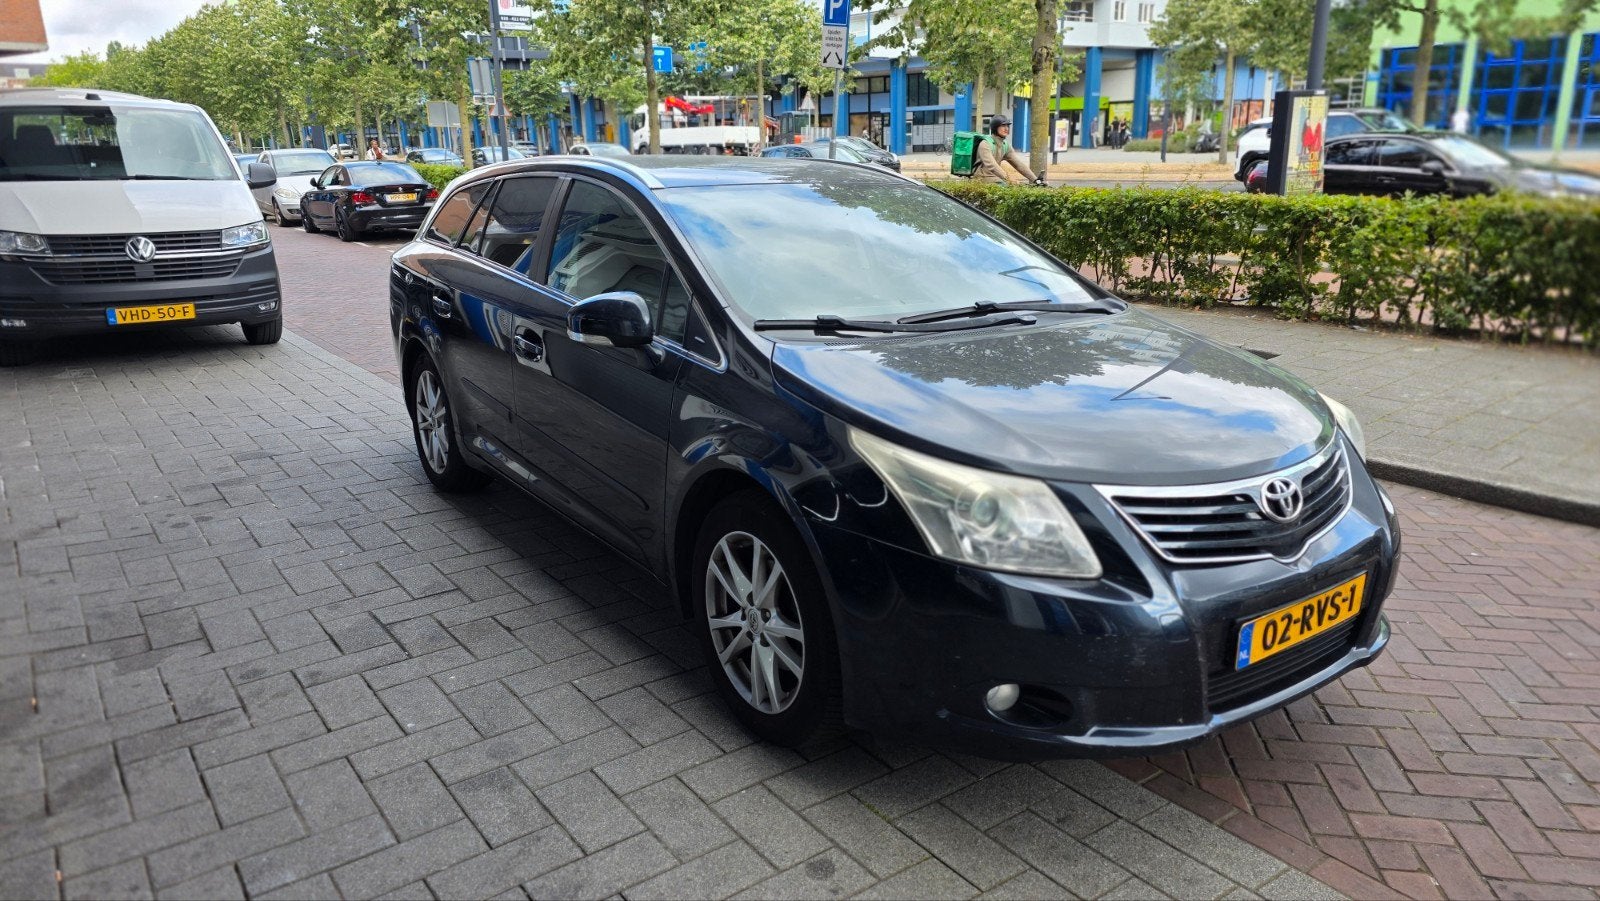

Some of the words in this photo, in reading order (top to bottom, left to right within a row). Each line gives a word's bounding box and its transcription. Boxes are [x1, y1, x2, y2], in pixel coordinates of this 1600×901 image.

[829, 0, 843, 19] P
[118, 306, 190, 321] VHD-50-F
[1240, 649, 1249, 659] NL
[1261, 583, 1357, 651] 02-RVS-1
